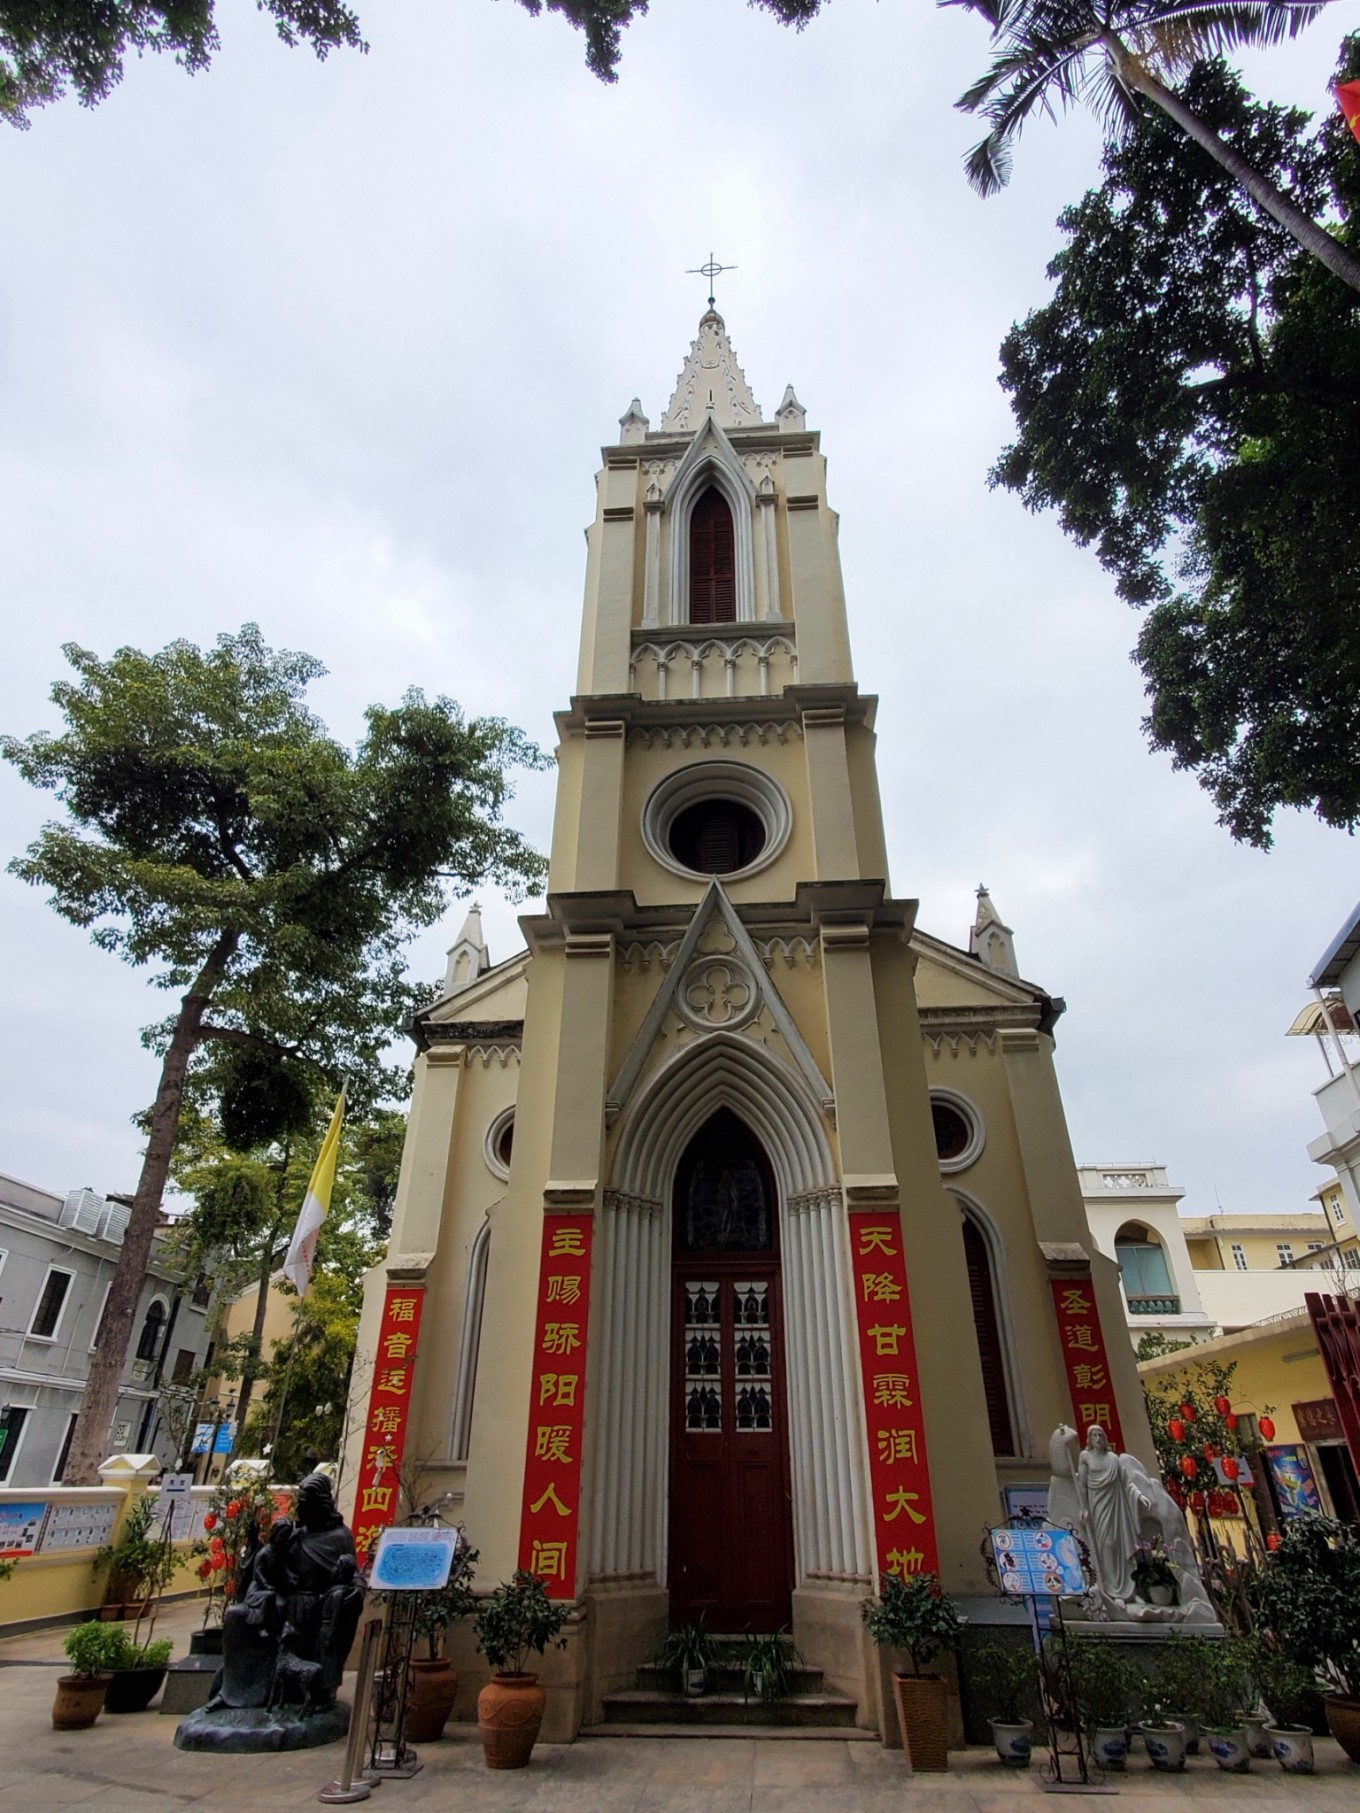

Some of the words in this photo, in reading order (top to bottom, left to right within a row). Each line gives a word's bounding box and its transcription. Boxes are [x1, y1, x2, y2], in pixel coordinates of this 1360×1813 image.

[530, 1228, 586, 1581] 主赐骄阳暖人间
[859, 1226, 927, 1585] 天降甘霖润大地
[1060, 1289, 1117, 1453] 圣道彰明
